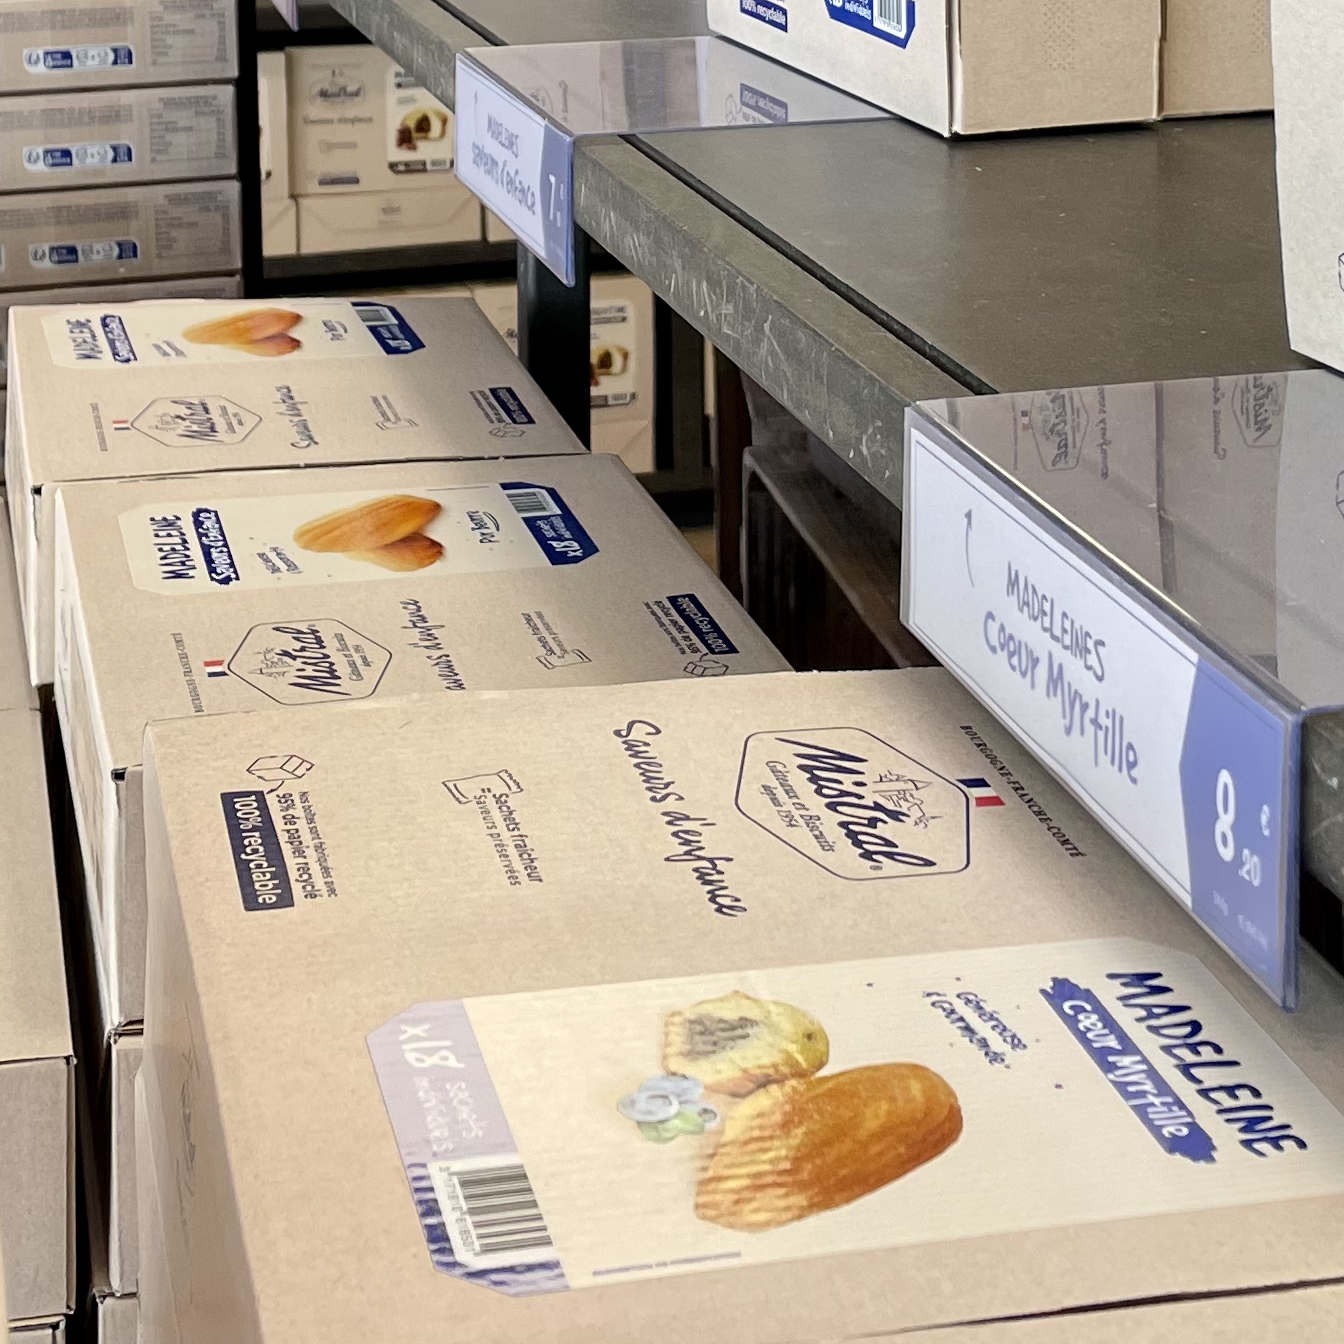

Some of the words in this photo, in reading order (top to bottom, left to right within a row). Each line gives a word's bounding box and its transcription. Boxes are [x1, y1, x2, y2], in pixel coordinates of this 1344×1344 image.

[150, 513, 197, 581] MADELEINE
[399, 598, 445, 650] d'enfance
[1006, 560, 1106, 682] MADELEINES
[272, 626, 352, 696] Mistral
[983, 610, 1040, 691] Coeur
[1046, 650, 1138, 785] Myrtille
[232, 795, 255, 830] 100%
[276, 792, 292, 818] 95%
[280, 813, 297, 827] de
[612, 719, 685, 804] Saveurs
[660, 810, 747, 917] d'enfance
[765, 760, 800, 802] Gâteaux
[797, 808, 836, 853] Biscuits
[774, 736, 937, 867] Mistral
[776, 806, 800, 829] 1954
[959, 724, 1086, 859] BOURGOGNE-FRANCHE-COMTÉ
[1215, 768, 1235, 862] 8
[1260, 804, 1270, 838] €
[240, 830, 278, 905] recyclable
[282, 827, 306, 859] papier
[474, 794, 498, 830] Saveurs
[487, 831, 522, 887] préservées
[492, 793, 521, 832] Sachets
[509, 832, 543, 884] fraîcheur
[1239, 848, 1261, 887] 20
[294, 854, 323, 900] recyclé
[398, 1024, 465, 1068] x18
[1106, 971, 1308, 1158] MADELEINE
[1107, 1054, 1189, 1139] Myrtille
